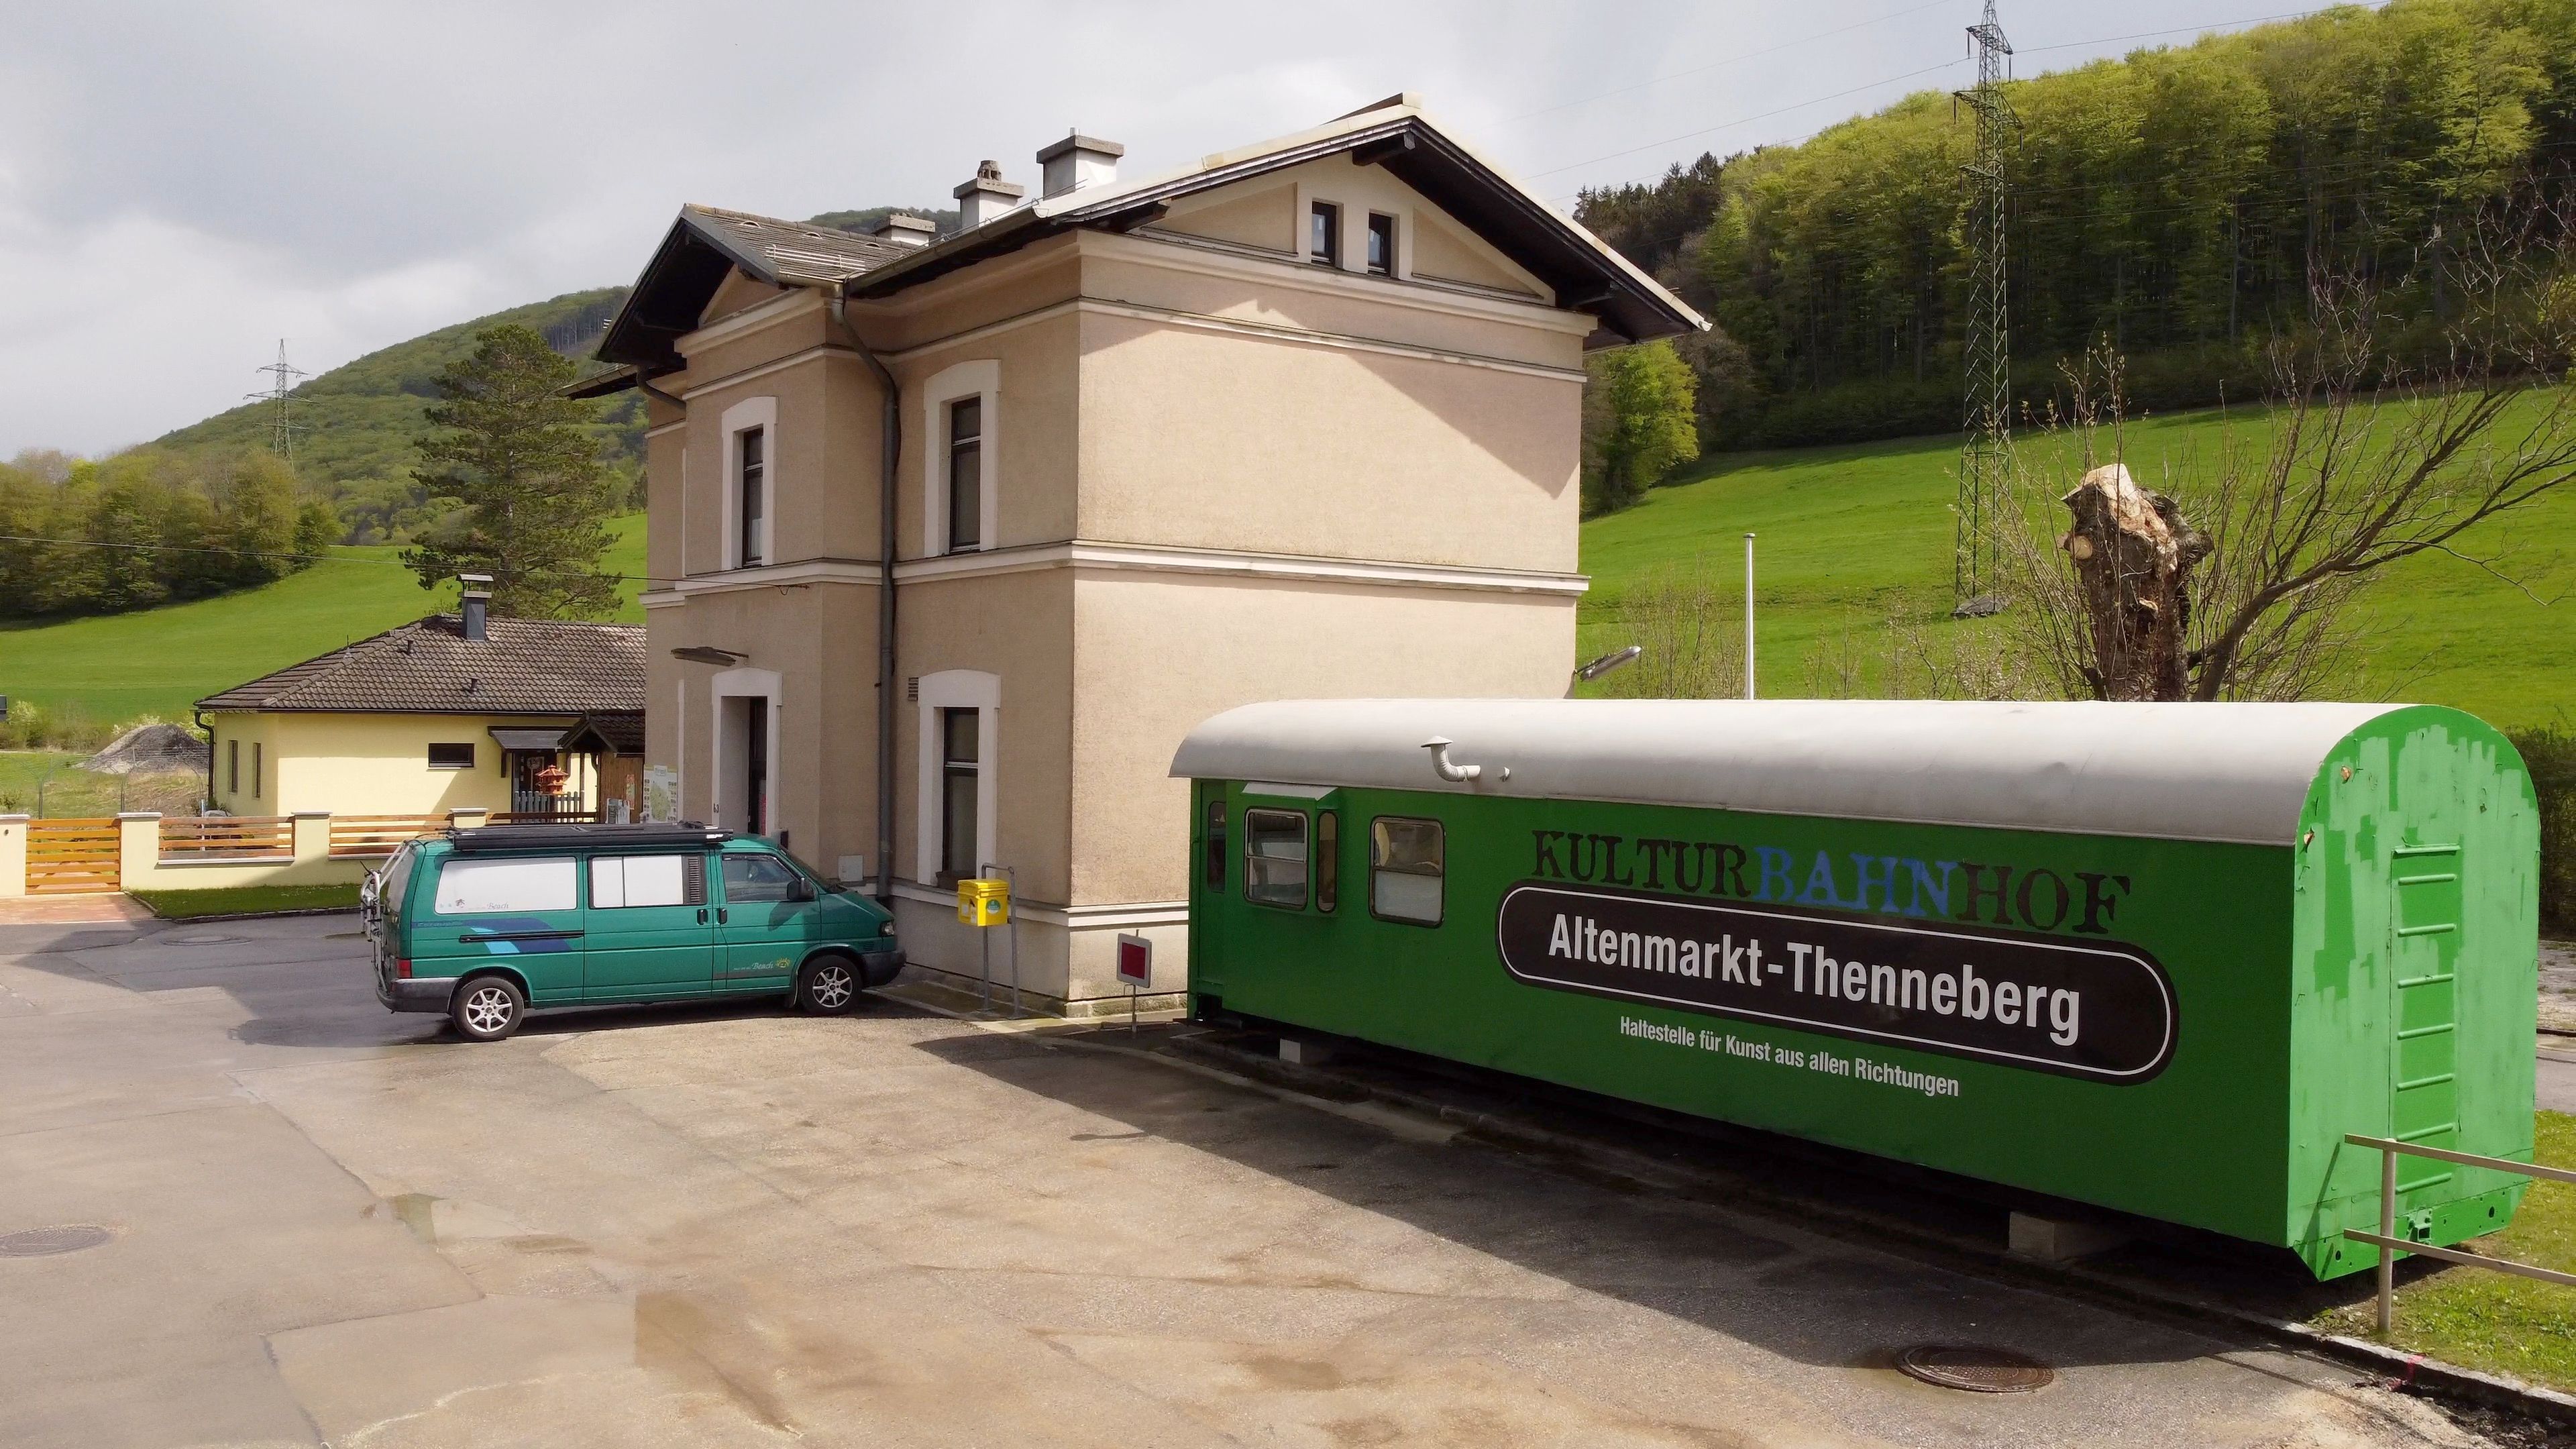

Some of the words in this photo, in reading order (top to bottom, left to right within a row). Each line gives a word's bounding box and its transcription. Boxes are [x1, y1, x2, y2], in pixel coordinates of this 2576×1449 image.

[1532, 830, 2131, 934] KULTURBAHNHOF
[751, 961, 773, 970] Beach
[1548, 914, 2082, 1046] Altenmarkt-Thenneberg
[1620, 1016, 1696, 1047] Haltestelle
[1699, 1029, 1722, 1052] für
[1725, 1034, 1770, 1062] Kunst
[1774, 1047, 1805, 1068] aus
[1809, 1051, 1849, 1077] allen
[1855, 1057, 1959, 1097] Richtungen
